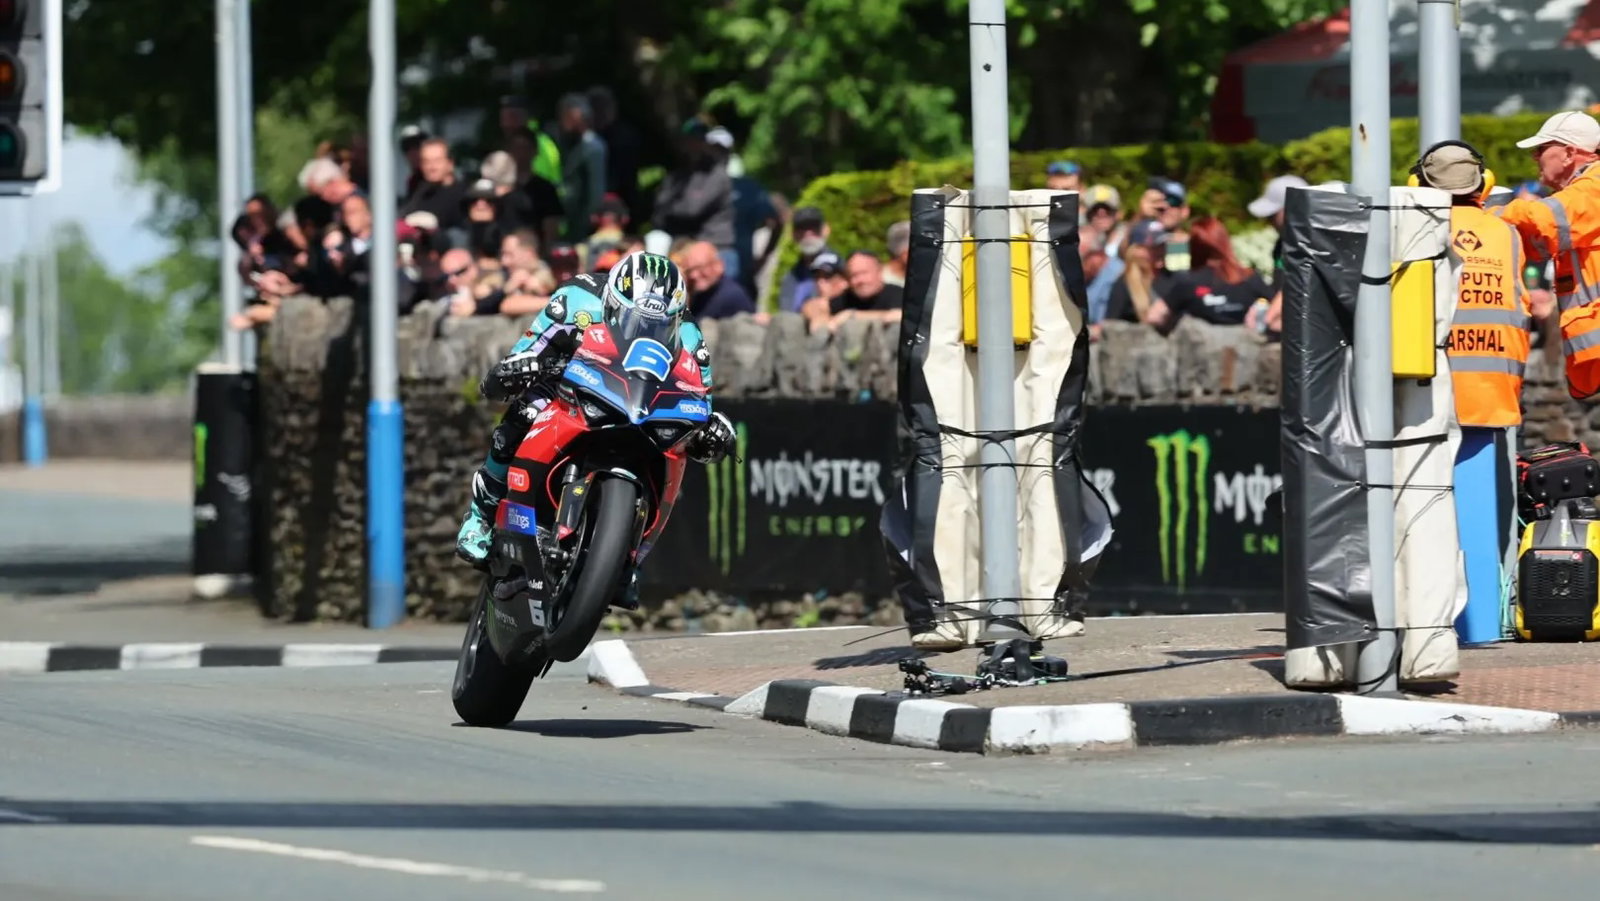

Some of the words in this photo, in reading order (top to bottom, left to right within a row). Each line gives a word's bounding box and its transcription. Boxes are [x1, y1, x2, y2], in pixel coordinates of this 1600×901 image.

[1461, 272, 1503, 288] PUTY
[638, 297, 665, 312] Arai
[1461, 289, 1503, 305] CTOR
[1446, 329, 1505, 352] ARSHAL
[622, 337, 673, 382] 6
[750, 450, 885, 507] MONSTER
